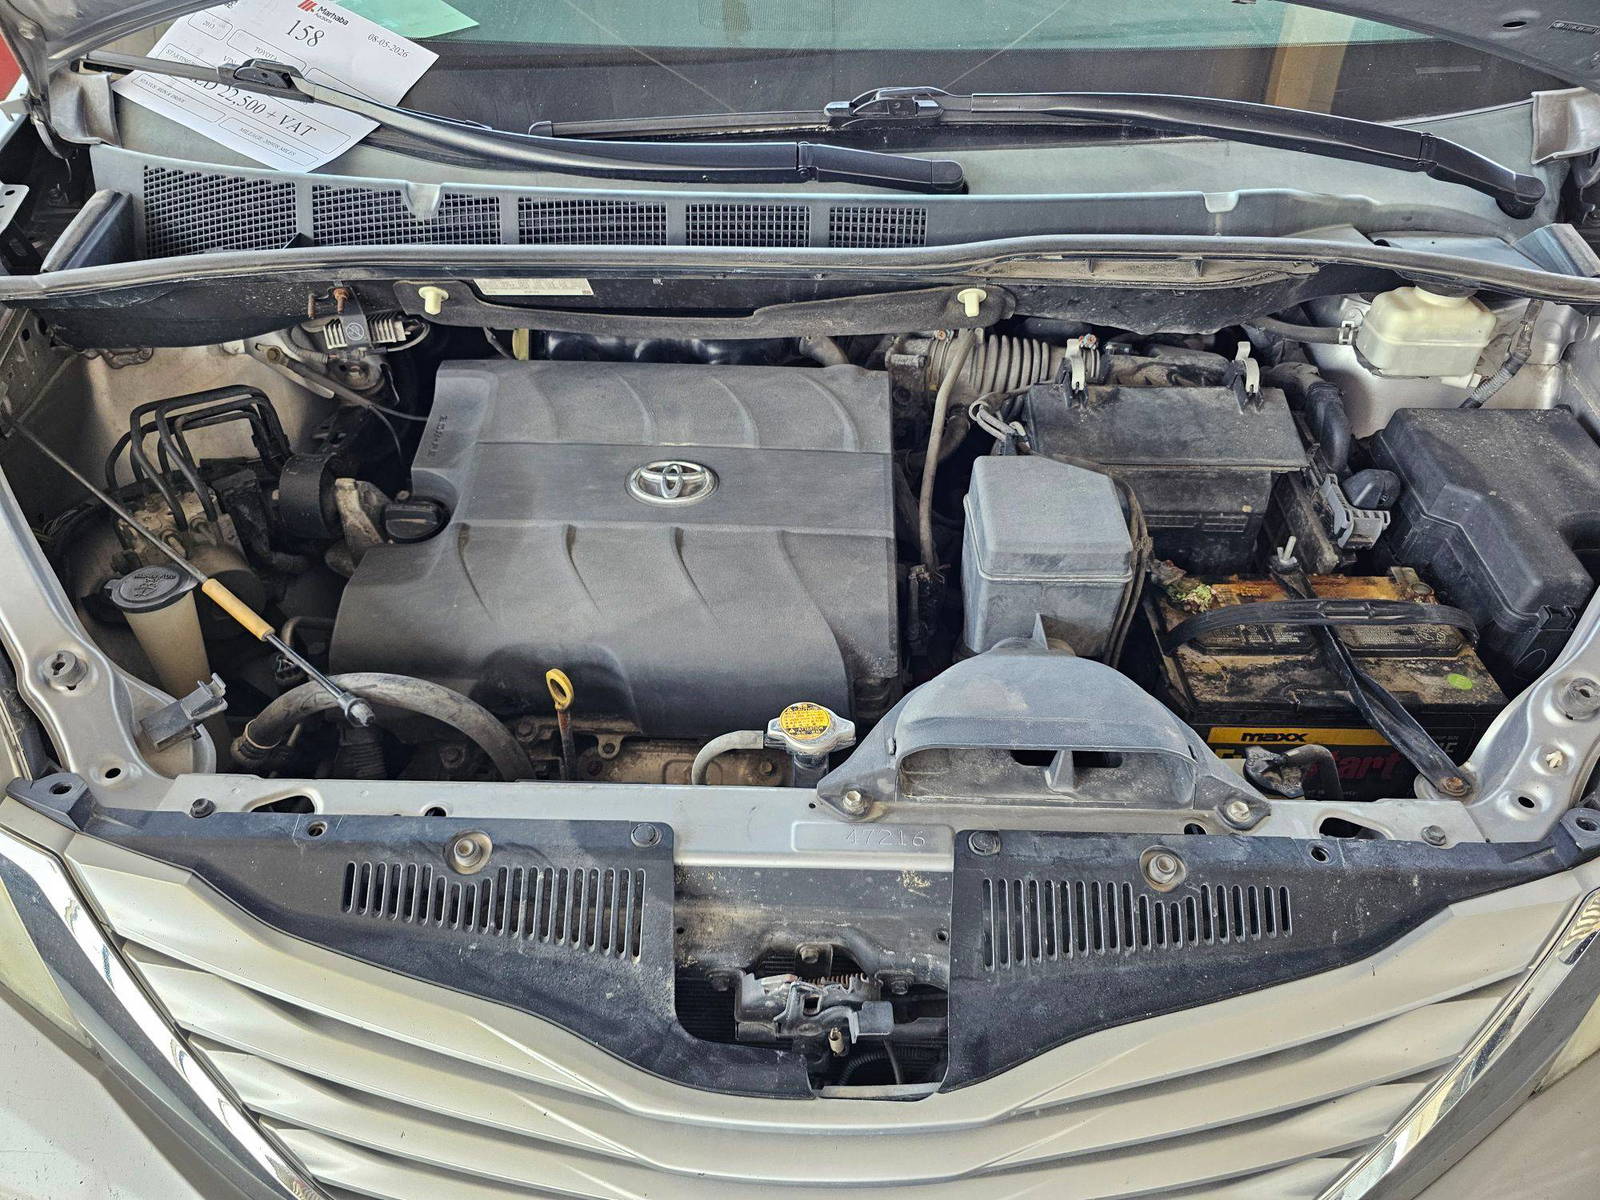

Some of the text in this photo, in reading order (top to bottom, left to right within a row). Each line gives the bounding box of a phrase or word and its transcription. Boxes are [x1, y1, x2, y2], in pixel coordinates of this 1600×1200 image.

[316, 6, 349, 26] Marhaba
[286, 19, 325, 48] 158
[254, 46, 278, 61] TOYOTA
[367, 33, 409, 58] 08-05-2026
[217, 85, 267, 115] 22,500
[279, 114, 317, 136] VAT
[1240, 732, 1309, 743] maxx
